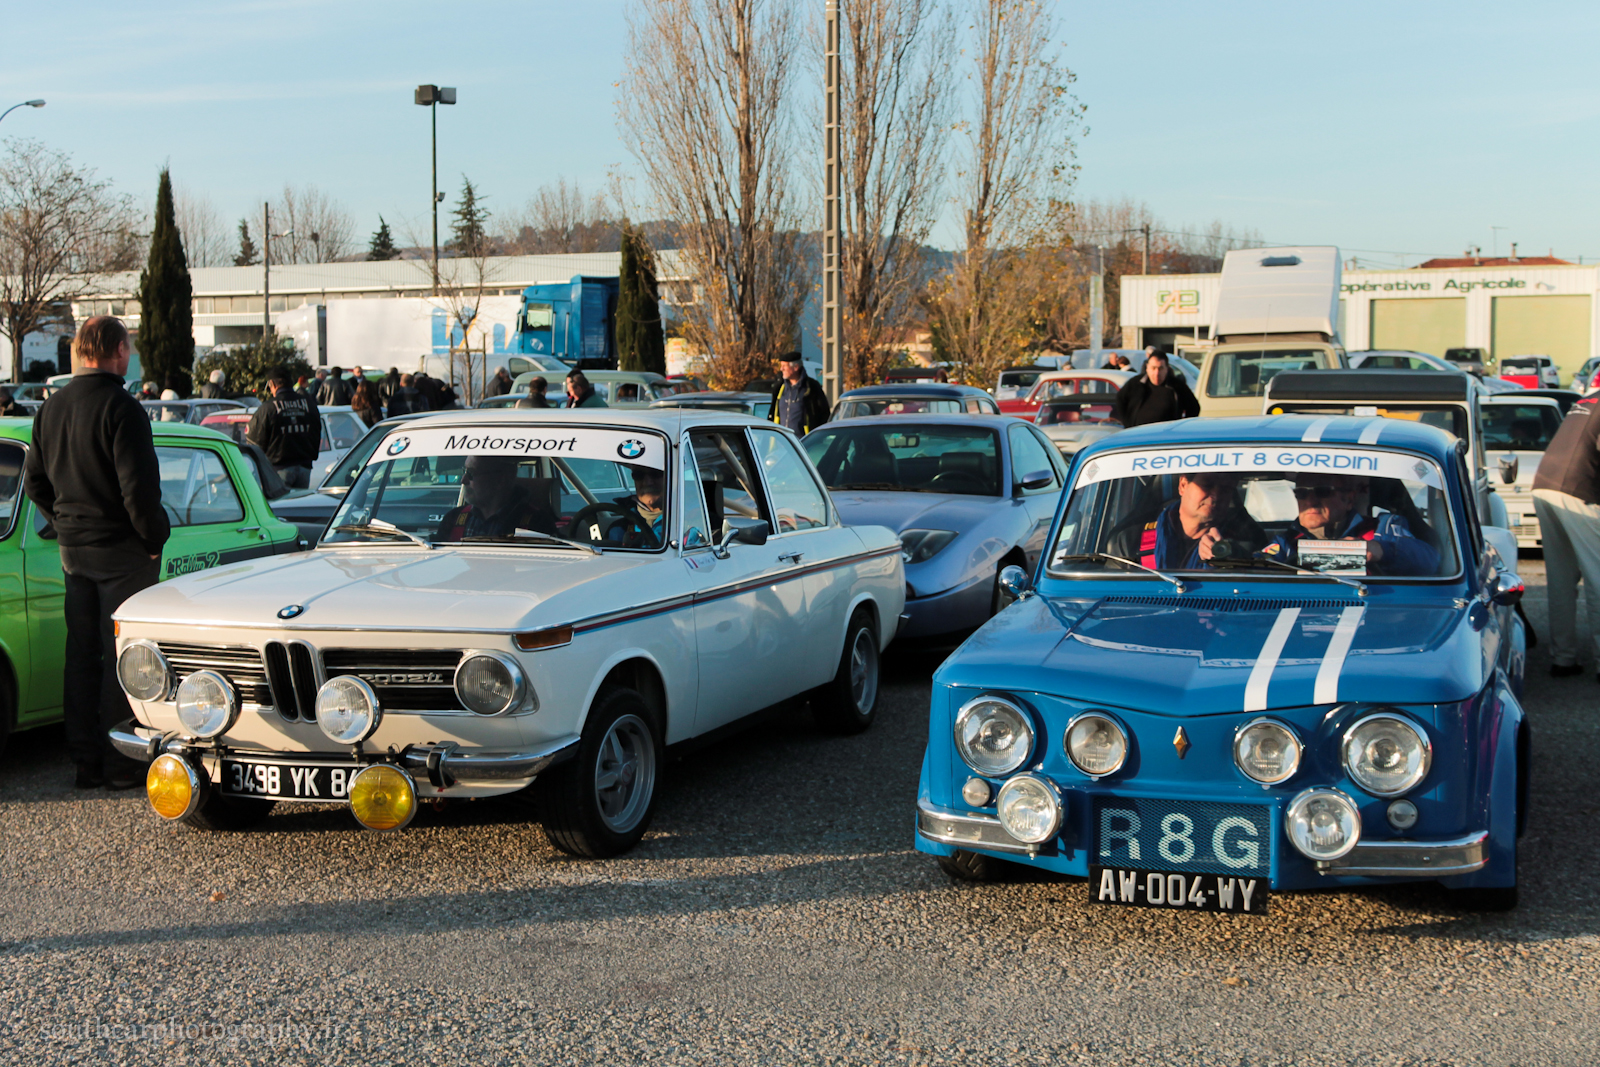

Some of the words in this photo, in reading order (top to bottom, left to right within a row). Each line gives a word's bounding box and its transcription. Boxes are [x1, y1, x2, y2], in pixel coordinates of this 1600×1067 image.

[1443, 277, 1526, 293] Agricole
[273, 398, 310, 415] LINCOLN
[445, 433, 578, 454] Motorsport
[1253, 452, 1267, 466] 8
[206, 551, 220, 569] 2
[230, 763, 281, 795] 3498
[290, 767, 320, 797] YK
[1098, 868, 1257, 913] AW-004-WY
